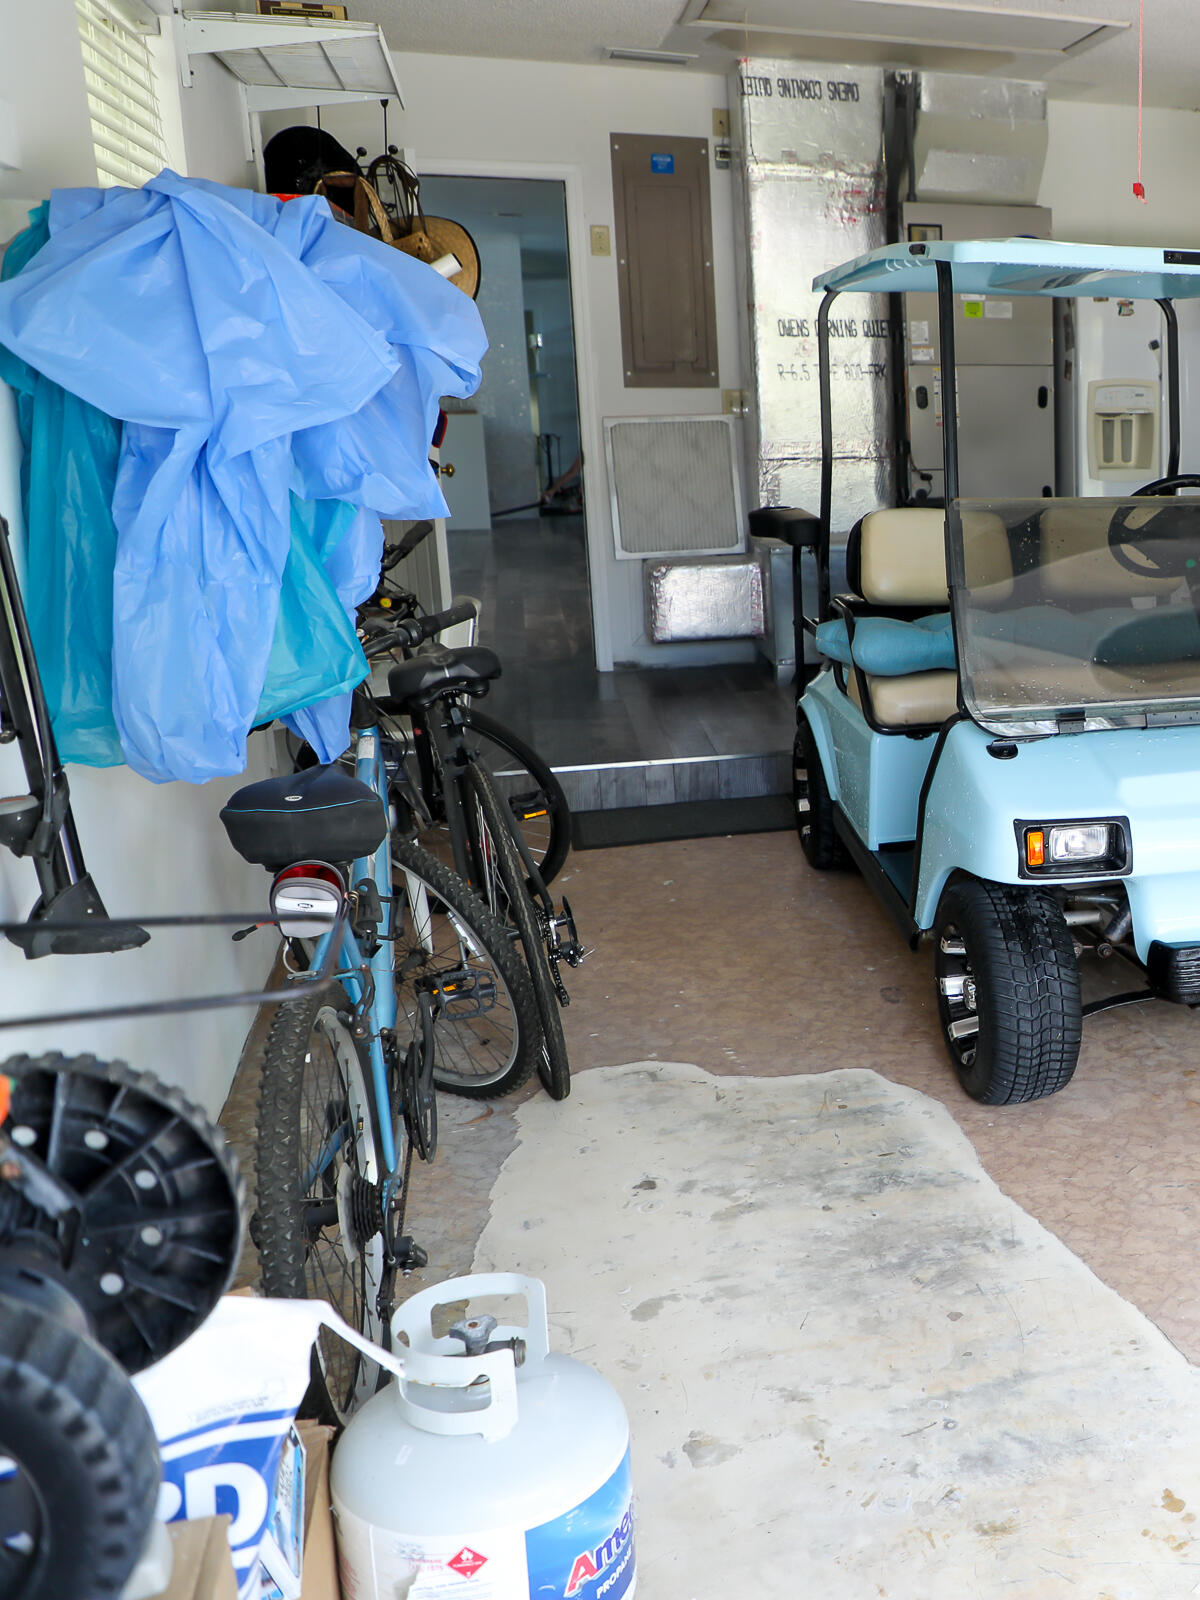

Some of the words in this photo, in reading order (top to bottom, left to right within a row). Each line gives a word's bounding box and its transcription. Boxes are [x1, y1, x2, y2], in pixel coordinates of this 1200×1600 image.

[776, 78, 822, 100] CORNING
[827, 81, 860, 102] OWENS
[777, 319, 810, 338] OWENS
[814, 319, 858, 338] CRNING
